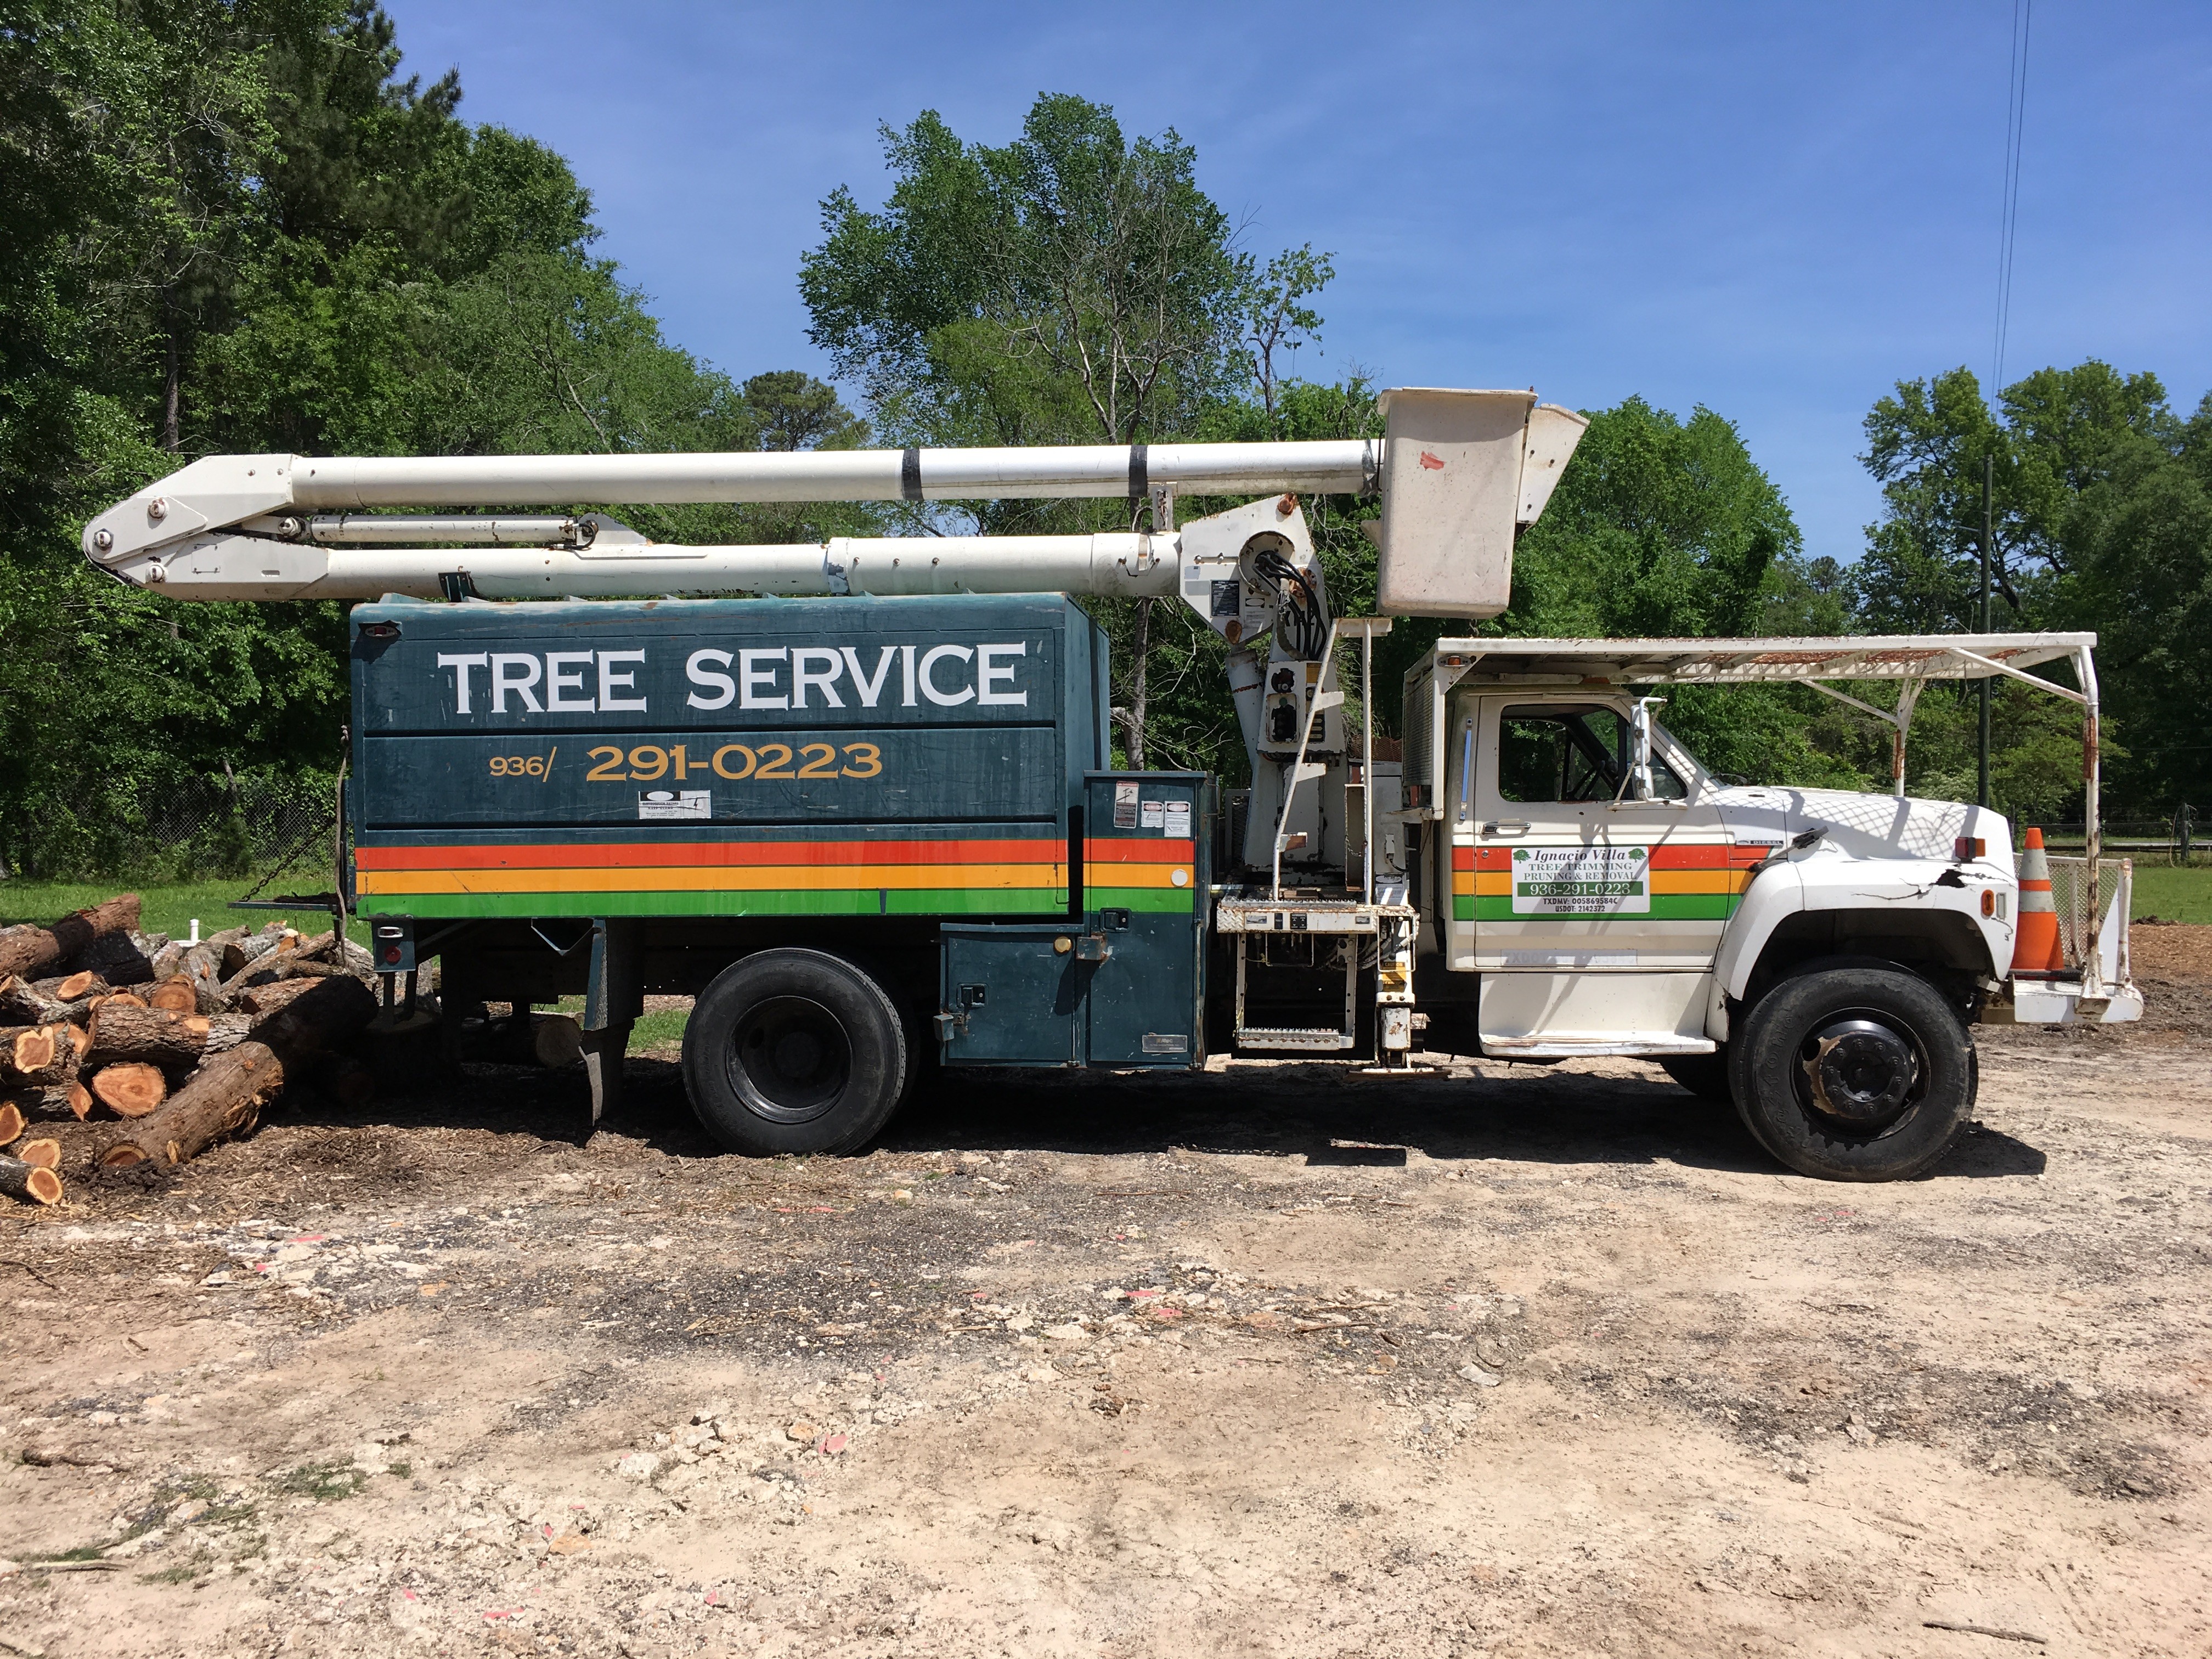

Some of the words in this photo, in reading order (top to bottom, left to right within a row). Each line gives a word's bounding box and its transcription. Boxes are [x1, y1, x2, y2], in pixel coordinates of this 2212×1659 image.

[437, 648, 647, 714] TREE
[686, 641, 1028, 711] SERVICE
[490, 746, 557, 782] 936/
[586, 743, 882, 781] 291-0223
[1533, 850, 1588, 863] Ignacio
[1592, 849, 1626, 860] Villa
[1567, 862, 1632, 871] TRIMMING
[1523, 872, 1572, 881] PRUNING
[1585, 872, 1637, 880] REMOVAL
[1530, 883, 1630, 896] 936-291-0223
